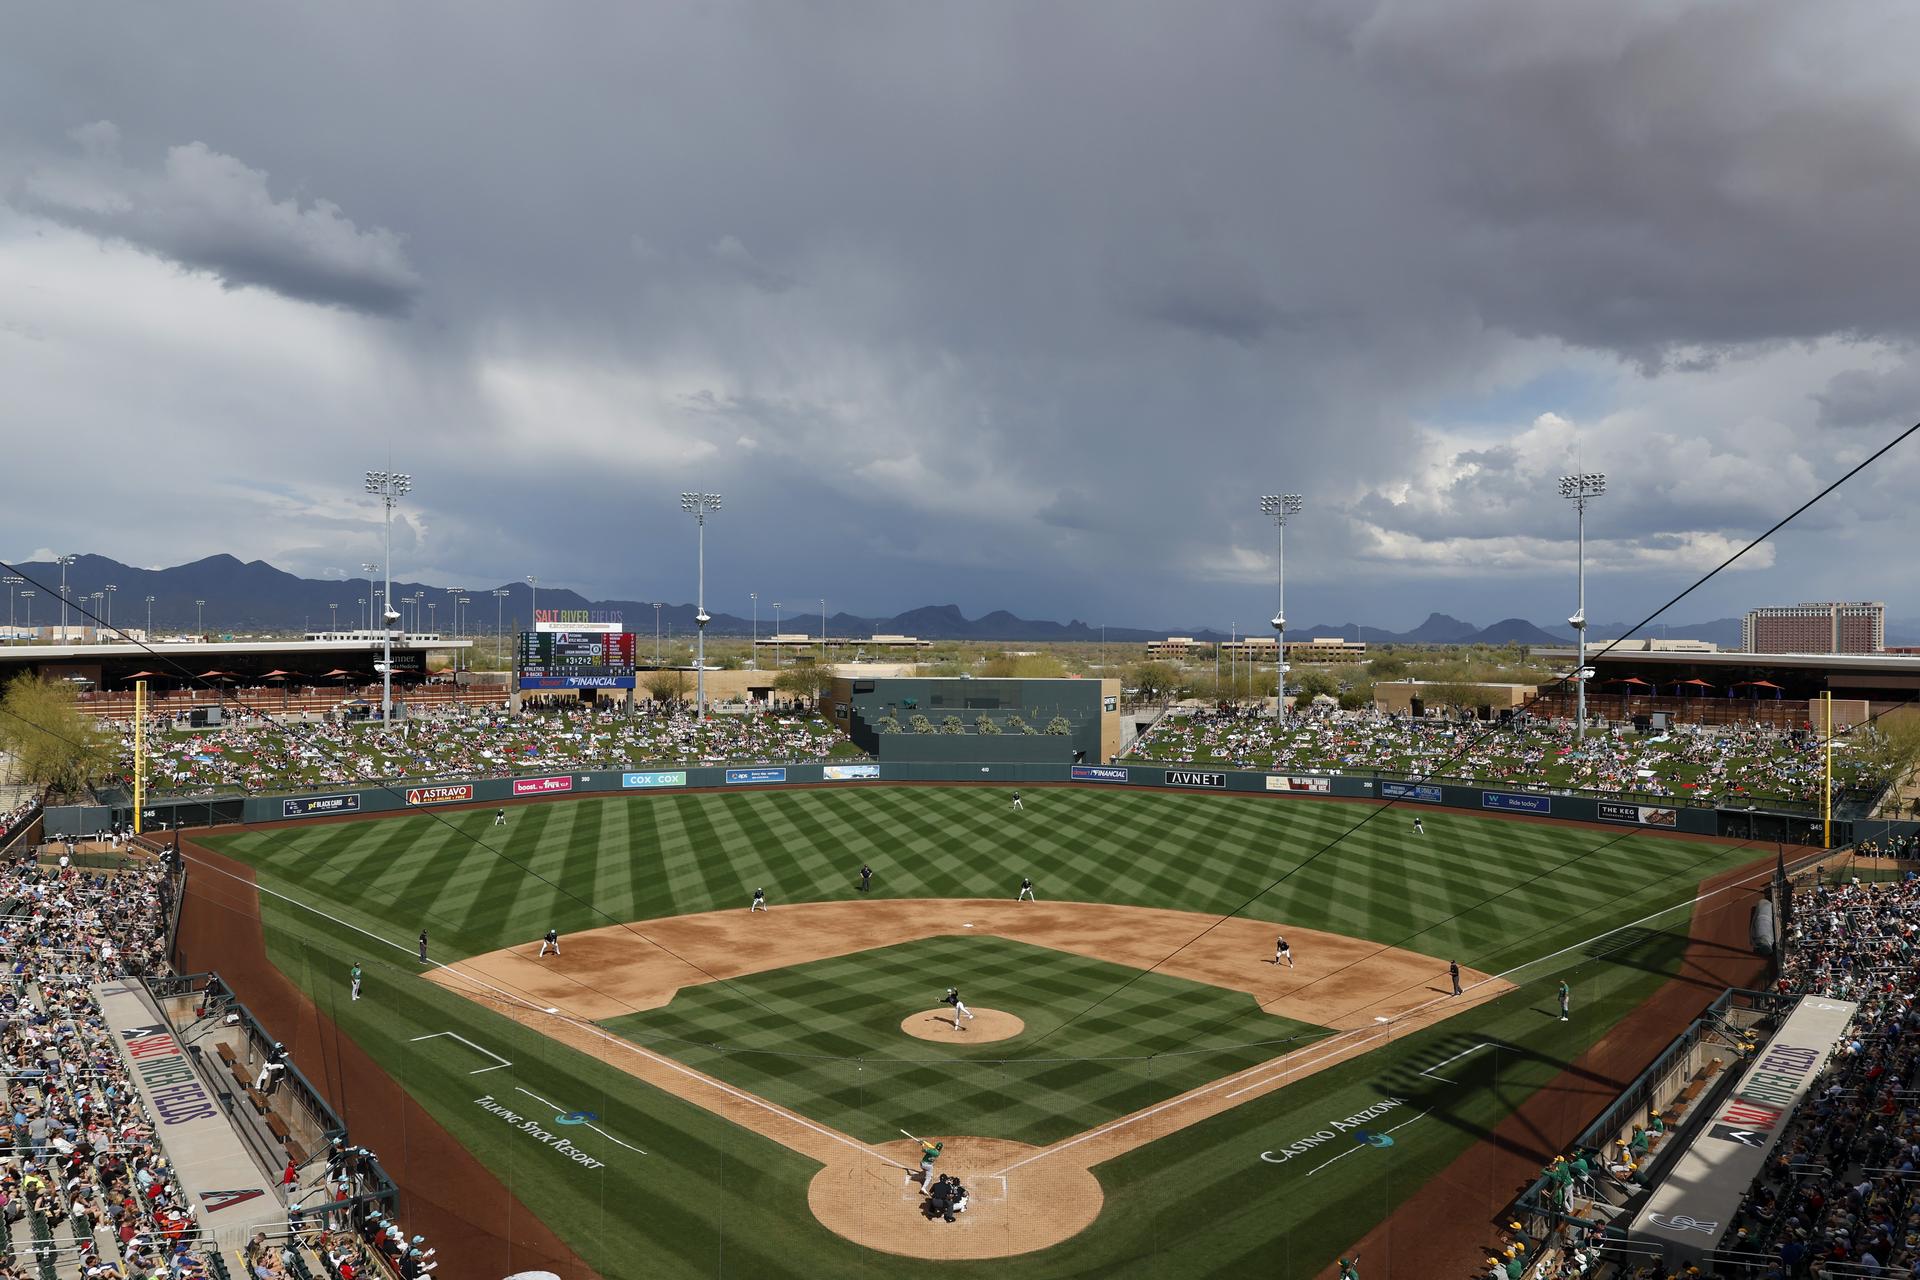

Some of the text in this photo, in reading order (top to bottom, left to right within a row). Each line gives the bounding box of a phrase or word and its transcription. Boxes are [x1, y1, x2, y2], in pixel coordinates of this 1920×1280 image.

[535, 609, 623, 623] SALT RIVER FIELDS
[570, 657, 575, 665] 3
[578, 657, 583, 665] 2
[587, 657, 592, 665] 2
[574, 677, 617, 686] FINANCIAL
[1095, 770, 1125, 778] FINANCIAL
[1171, 772, 1219, 785] AVNET
[630, 775, 679, 784] COX COX
[423, 787, 467, 798] ASTRAVO
[316, 800, 331, 808] BLACK
[331, 799, 343, 807] CARD
[143, 810, 156, 818] 345
[1810, 823, 1823, 831] 345
[126, 1035, 217, 1126] SALT RIVER FIELDS
[1722, 1043, 1820, 1131] SALT RIVER FIELDS
